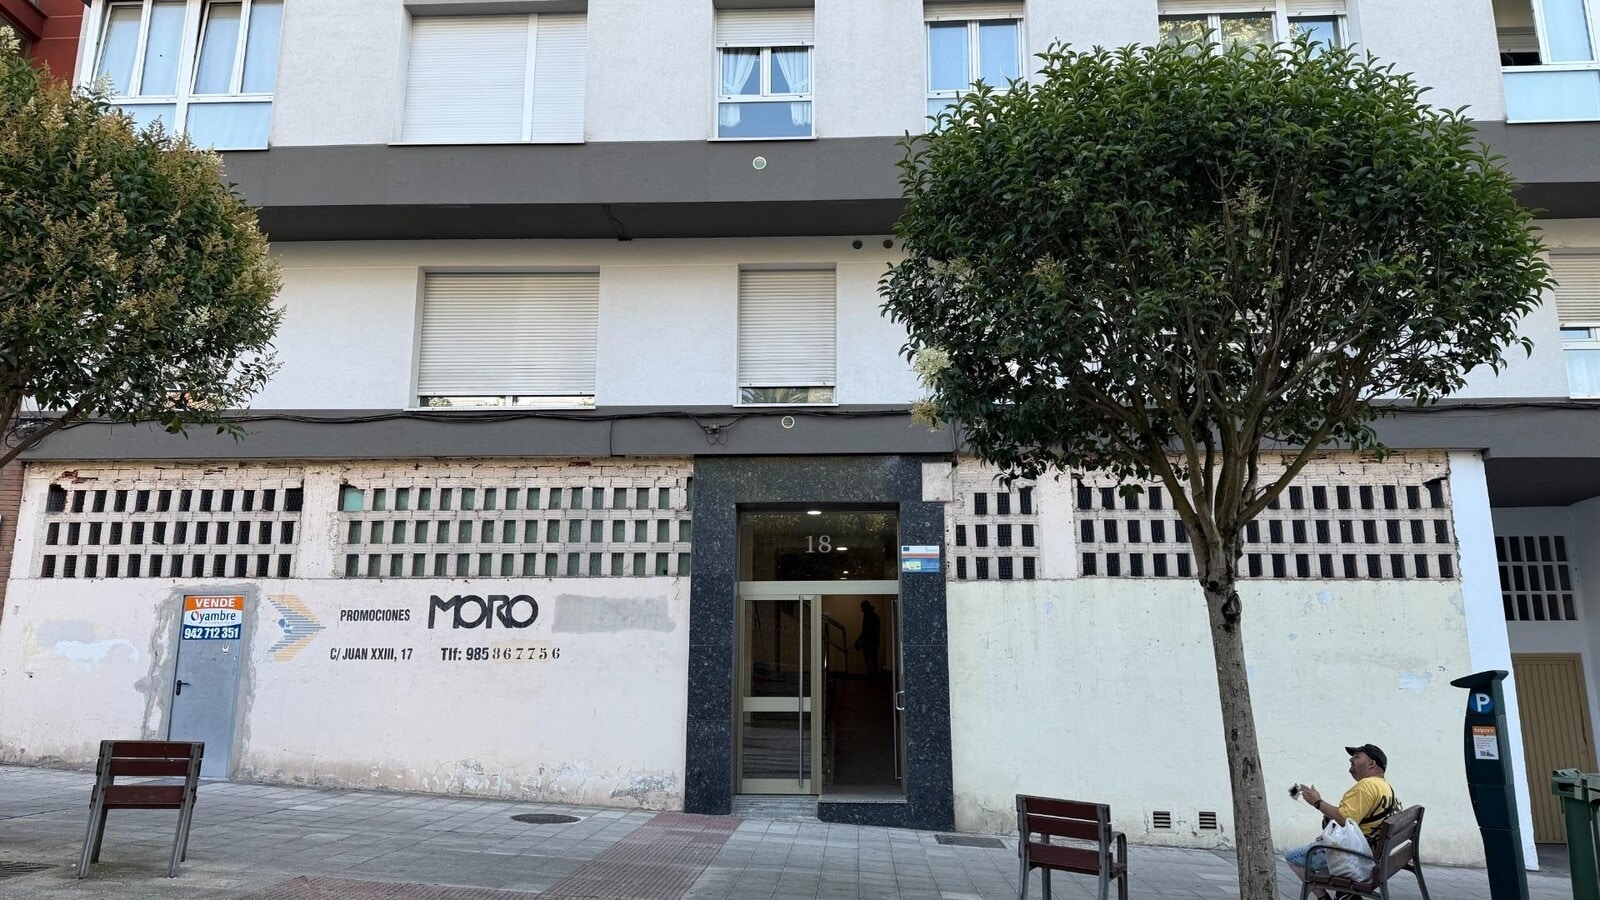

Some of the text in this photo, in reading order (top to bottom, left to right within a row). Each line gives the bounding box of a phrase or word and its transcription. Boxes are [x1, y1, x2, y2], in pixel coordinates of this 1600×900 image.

[805, 534, 832, 554] 18
[195, 598, 236, 608] VENDE
[190, 610, 236, 624] Oyambre
[340, 594, 539, 629] PROMOCIONES MORO
[184, 627, 239, 639] 942 712 351
[329, 647, 341, 661] C/
[342, 647, 368, 660] JUAN
[370, 647, 397, 662] XXIII,
[401, 647, 414, 660] 17
[441, 647, 462, 661] Tlf:
[1475, 693, 1490, 713] P
